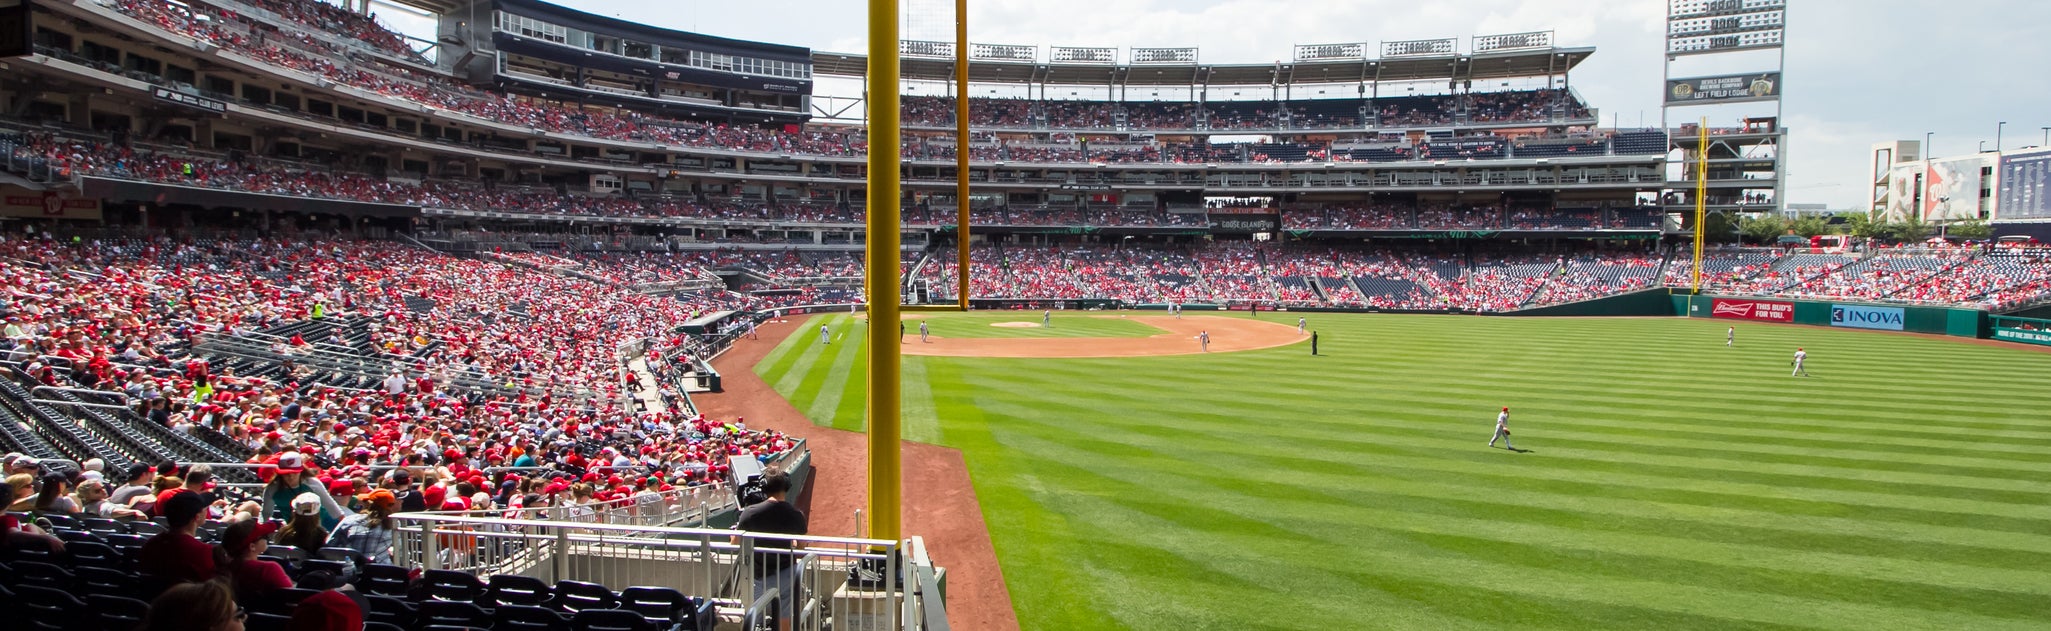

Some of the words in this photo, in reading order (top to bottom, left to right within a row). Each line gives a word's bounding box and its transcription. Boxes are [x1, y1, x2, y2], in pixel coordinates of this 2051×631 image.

[1694, 91, 1709, 99] LEFT
[1710, 90, 1727, 98] FIELD
[1728, 88, 1749, 97] LODGE
[1221, 220, 1240, 228] GOOSE
[1755, 303, 1771, 311] THIS
[1771, 303, 1792, 312] BUD'S
[1769, 311, 1785, 319] YOU.
[1849, 310, 1902, 324] INOVA
